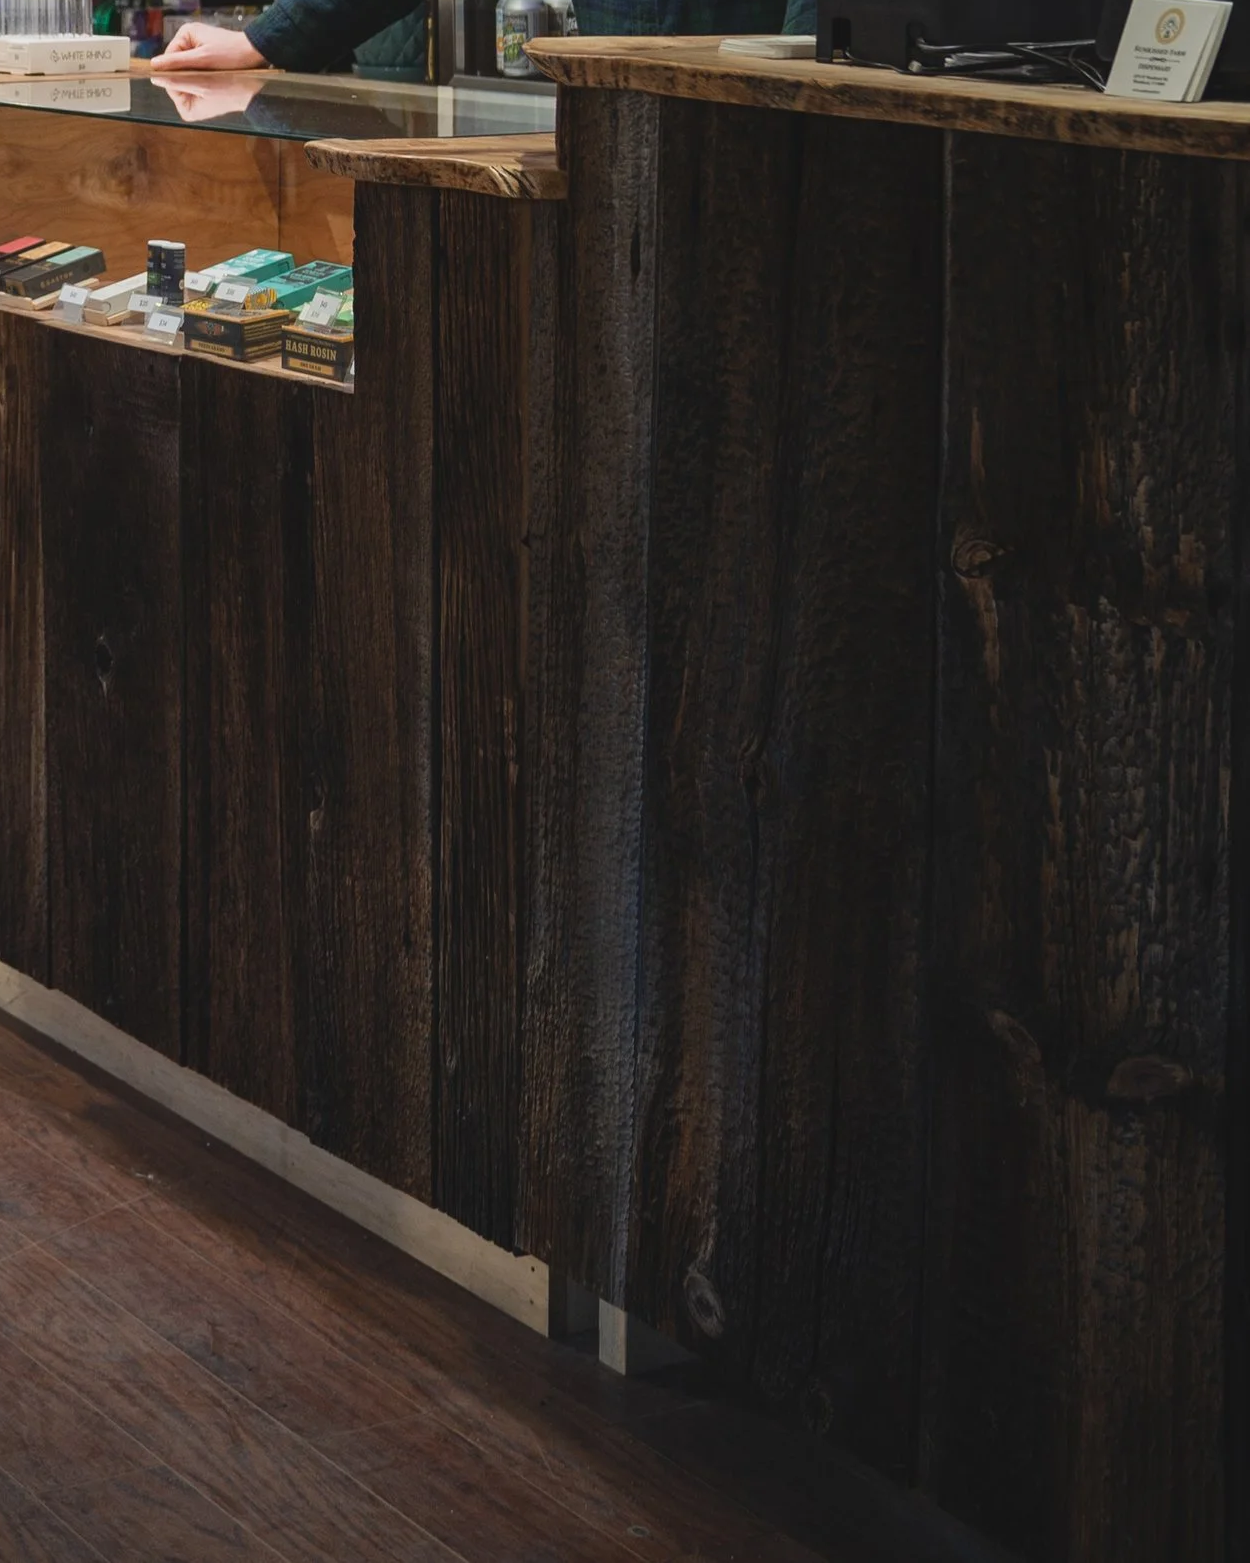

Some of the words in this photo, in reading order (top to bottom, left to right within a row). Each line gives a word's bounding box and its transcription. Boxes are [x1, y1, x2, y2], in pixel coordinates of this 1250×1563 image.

[61, 51, 84, 61] WHITE
[86, 50, 112, 60] RHINO
[285, 339, 308, 355] HASH
[310, 345, 337, 361] ROSIN
